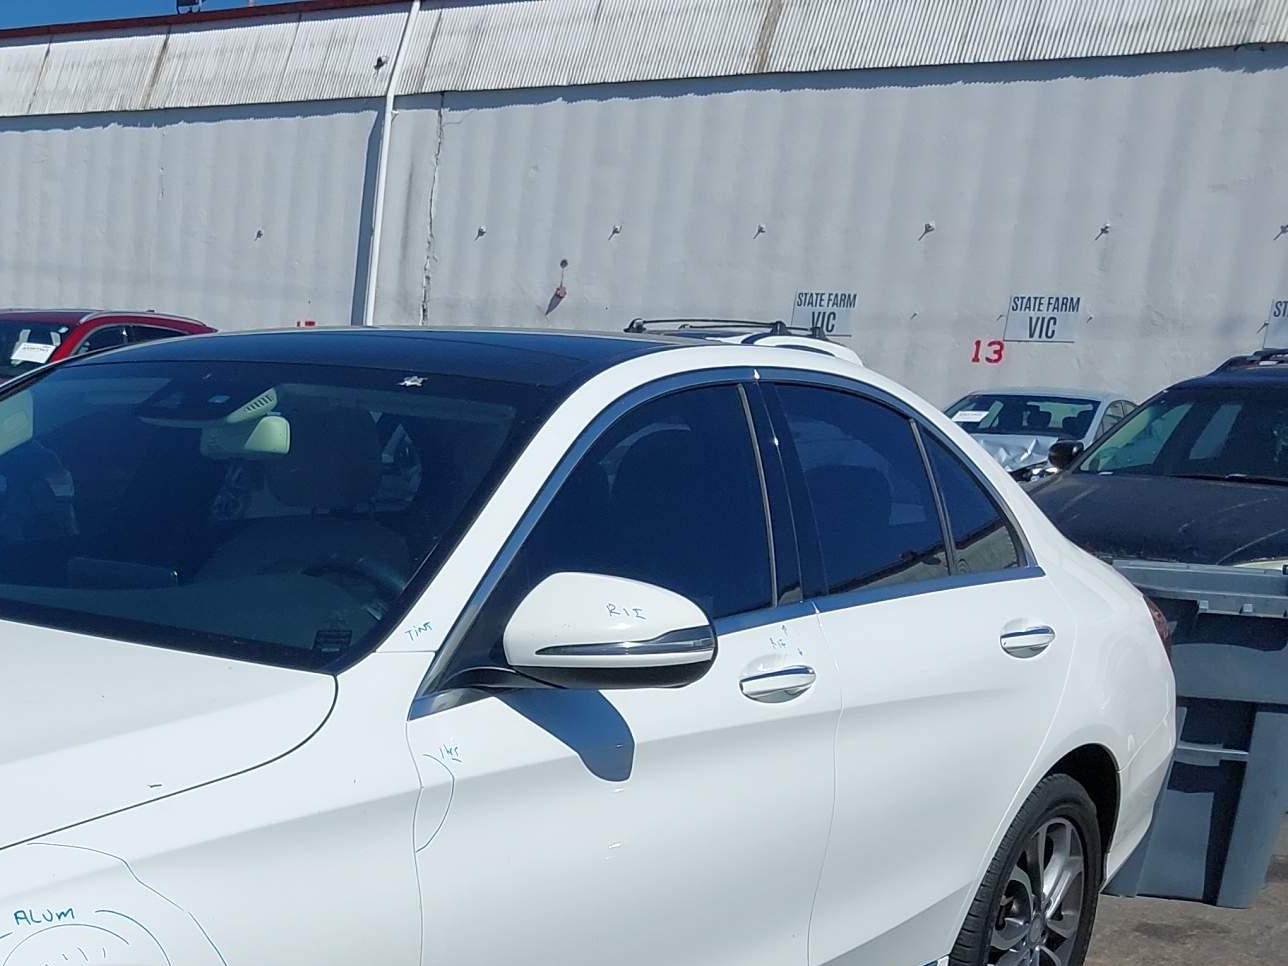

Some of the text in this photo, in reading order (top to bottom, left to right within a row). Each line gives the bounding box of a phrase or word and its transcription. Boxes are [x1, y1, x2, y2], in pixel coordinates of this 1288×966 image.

[796, 292, 858, 309] STATE FARM
[1011, 296, 1081, 313] STATE FARM
[1273, 300, 1288, 318] ST
[811, 311, 837, 333] VIC
[1028, 316, 1057, 340] VIC
[971, 339, 1005, 364] 13
